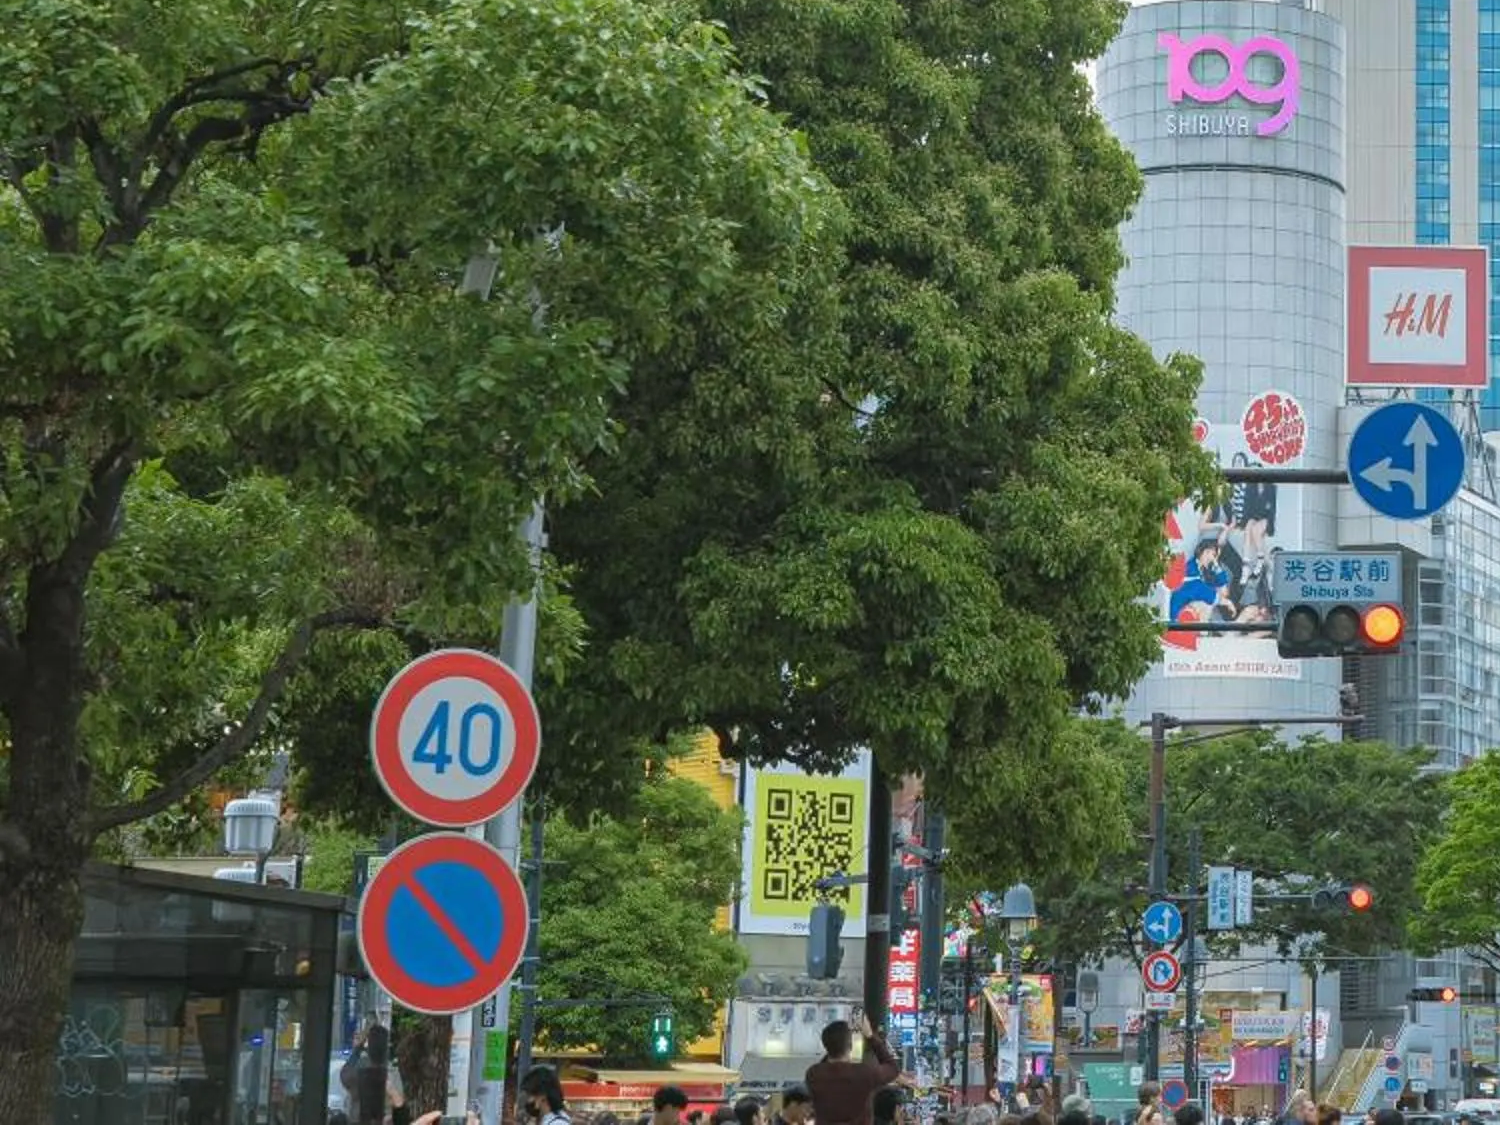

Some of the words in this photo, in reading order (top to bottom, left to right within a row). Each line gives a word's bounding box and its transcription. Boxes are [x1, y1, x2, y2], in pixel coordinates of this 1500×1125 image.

[1158, 34, 1300, 136] 109
[1166, 114, 1249, 136] SHIBUYA
[1383, 293, 1453, 339] H&M
[1284, 559, 1390, 582] 渋谷駅前
[1301, 585, 1349, 599] Shibuya
[411, 700, 502, 777] 40
